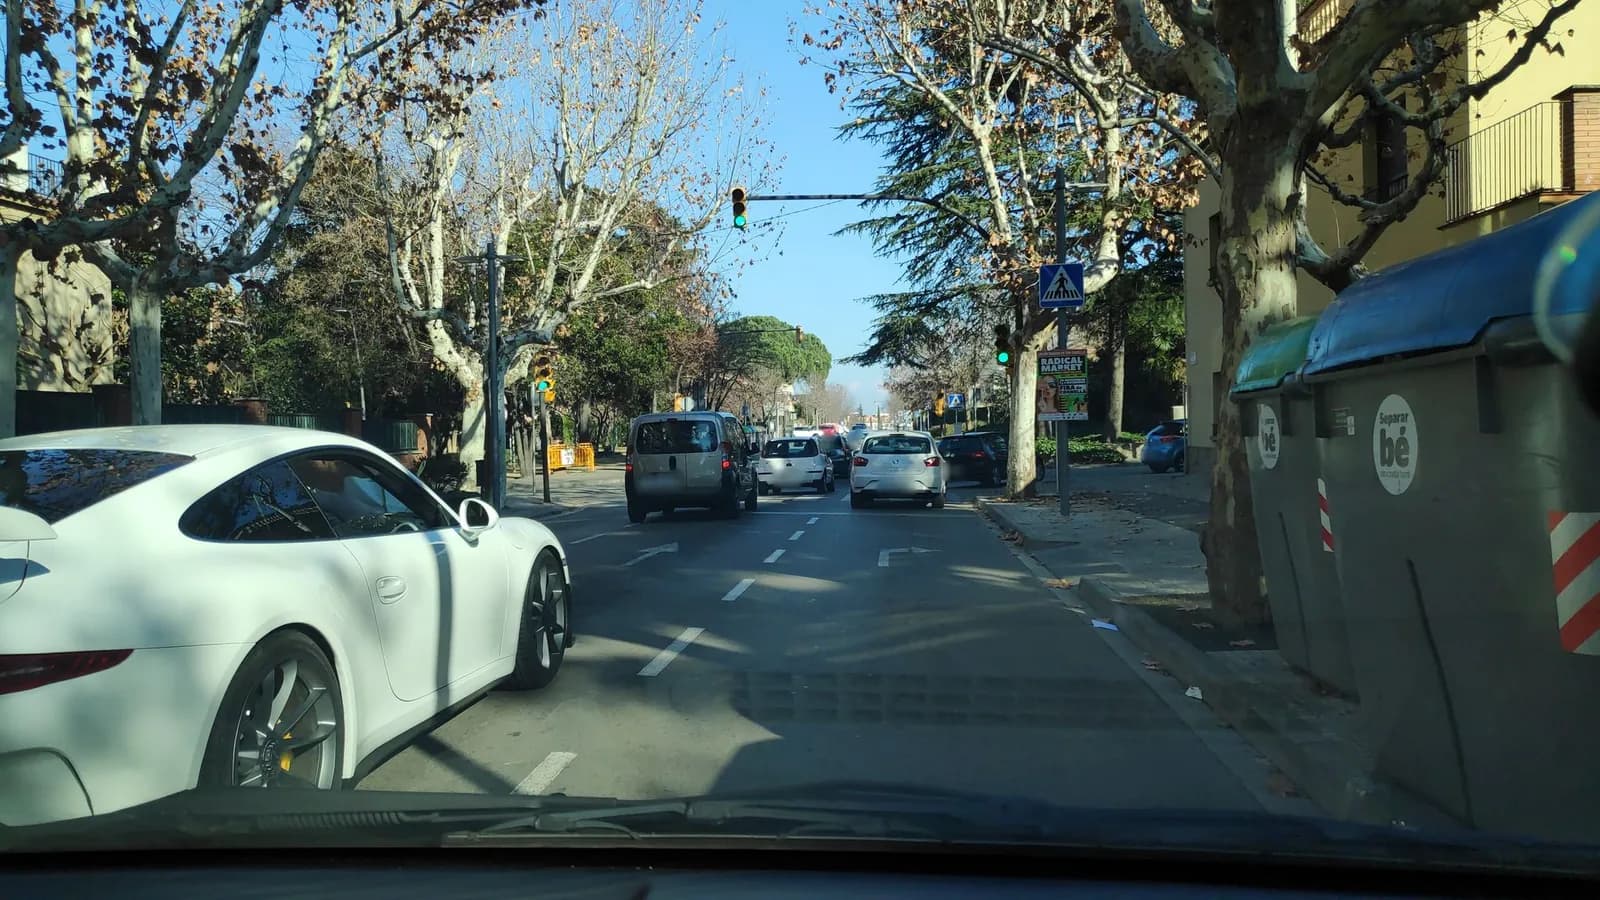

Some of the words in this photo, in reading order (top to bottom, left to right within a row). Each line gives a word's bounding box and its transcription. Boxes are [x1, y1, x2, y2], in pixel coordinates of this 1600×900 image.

[1041, 357, 1083, 365] RADICAL
[1041, 364, 1082, 372] MARKET
[1380, 412, 1408, 427] Separar
[1380, 426, 1410, 468] bé
